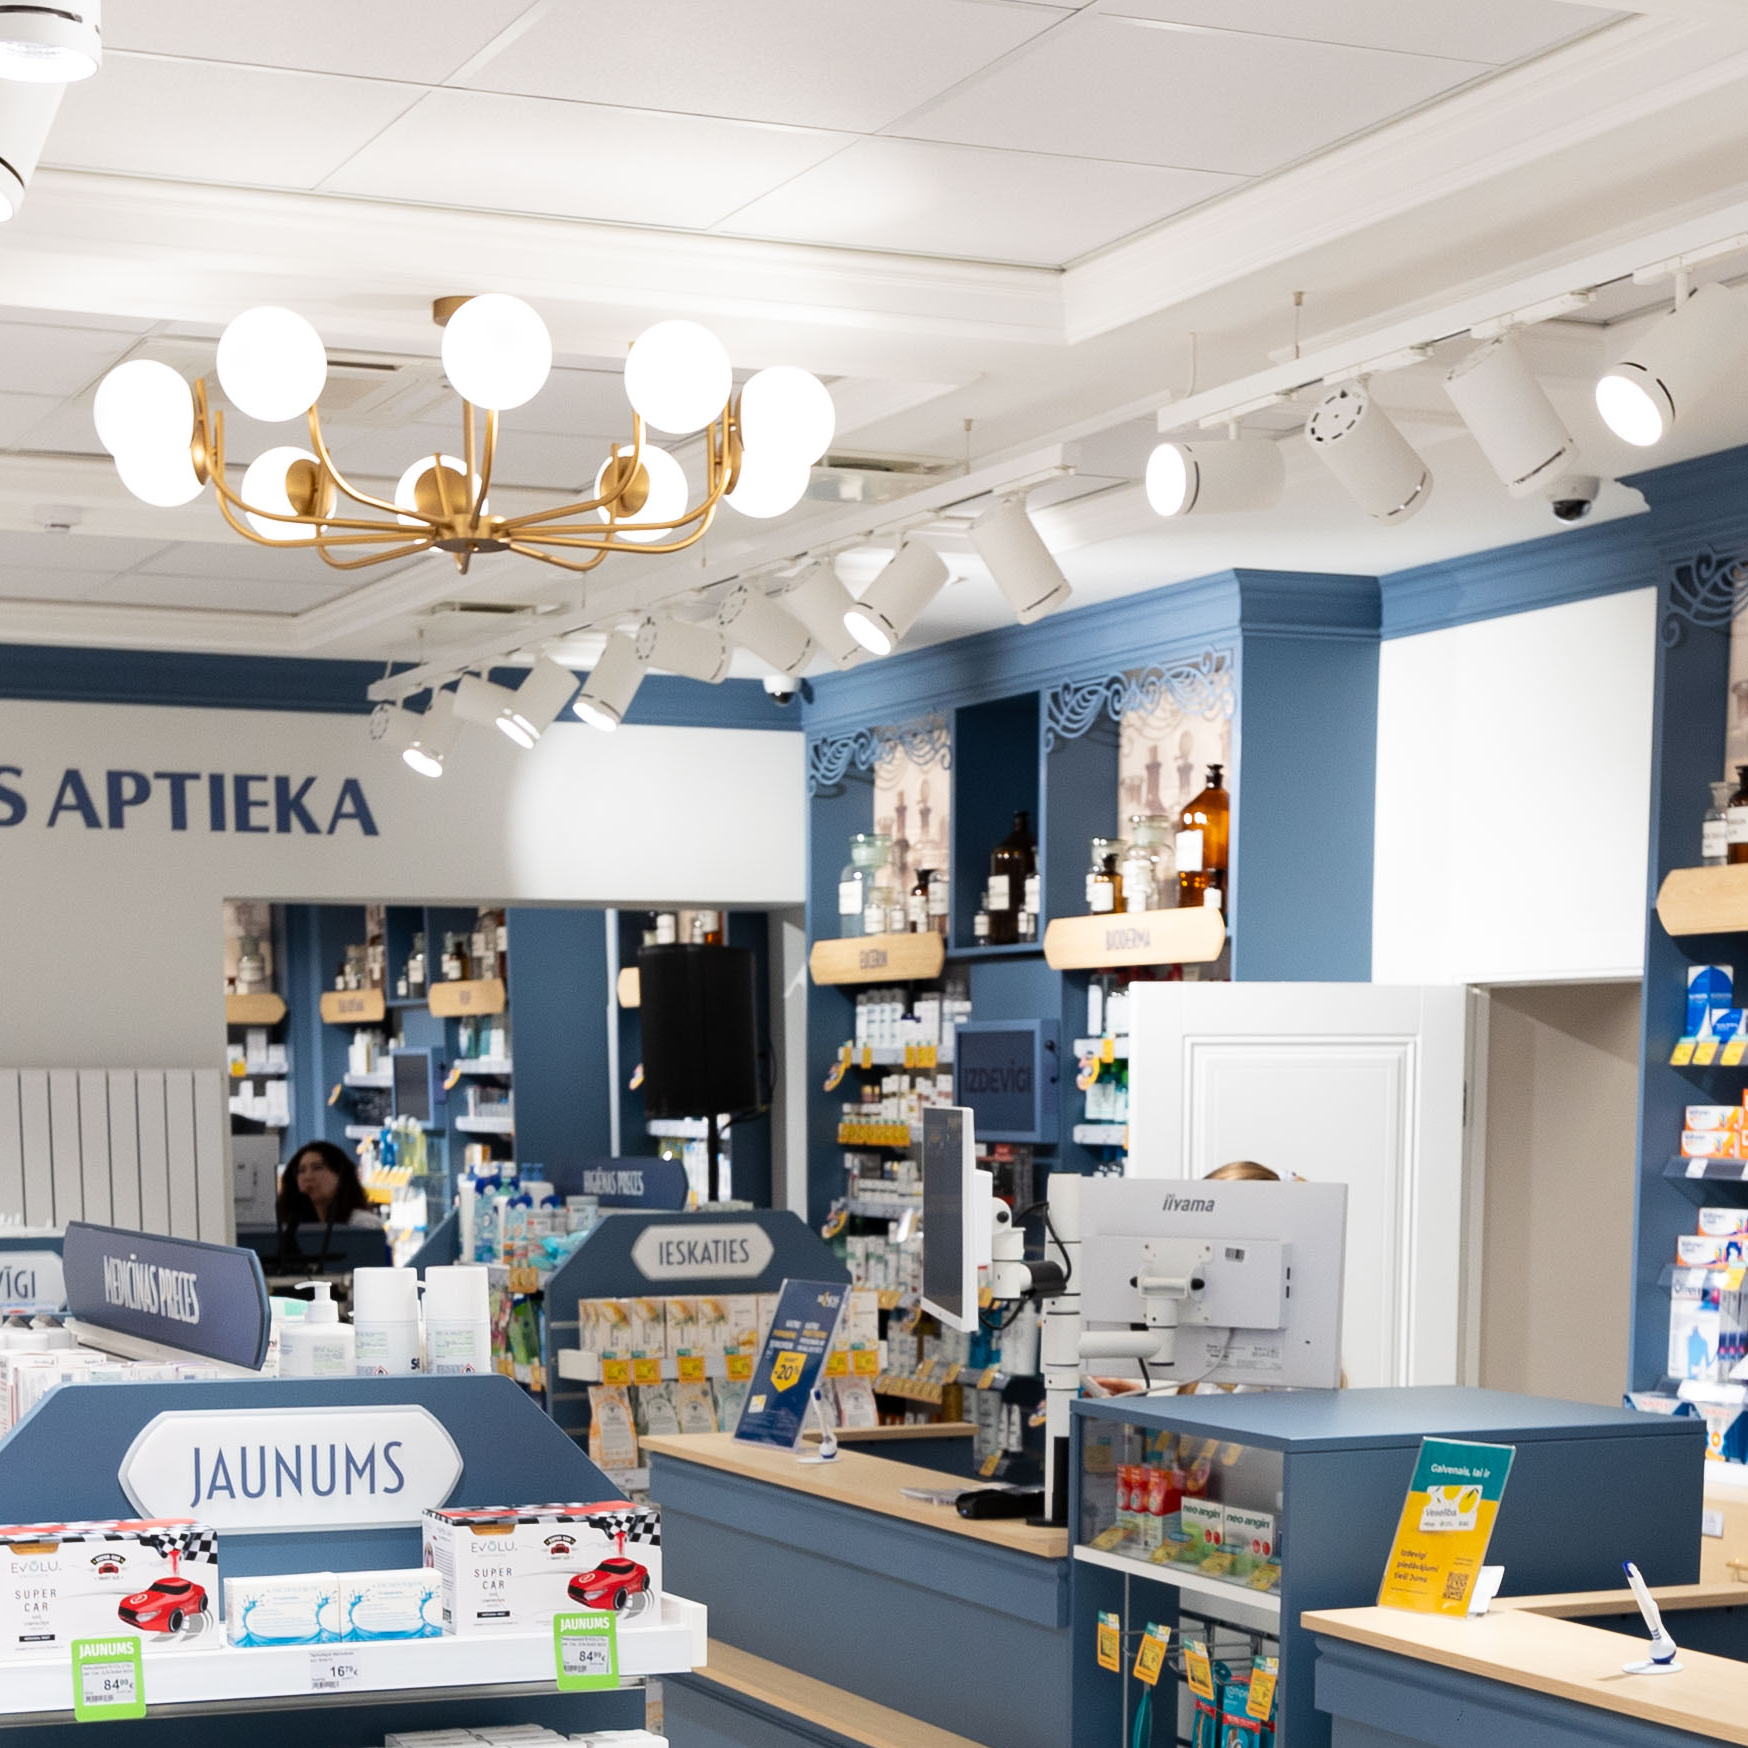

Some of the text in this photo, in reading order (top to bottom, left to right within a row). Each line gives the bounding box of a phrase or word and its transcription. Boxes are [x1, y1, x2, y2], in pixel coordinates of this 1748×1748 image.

[47, 768, 380, 836] APTIEKA
[1162, 1194, 1215, 1213] iiyama
[659, 1239, 749, 1266] IESKATIES
[103, 1254, 200, 1325] MEDICĪNAS PRECES
[190, 1441, 405, 1508] JAUNUMS
[1431, 1463, 1491, 1478] Galvenais, lai ir
[1425, 1508, 1457, 1517] Veselība
[474, 1567, 513, 1578] SUPER
[482, 1580, 505, 1590] CAR
[15, 1588, 57, 1599] SUPER
[24, 1601, 49, 1612] CAR
[560, 1616, 610, 1632] JAUNUMS
[79, 1640, 134, 1659] JAUNUMS
